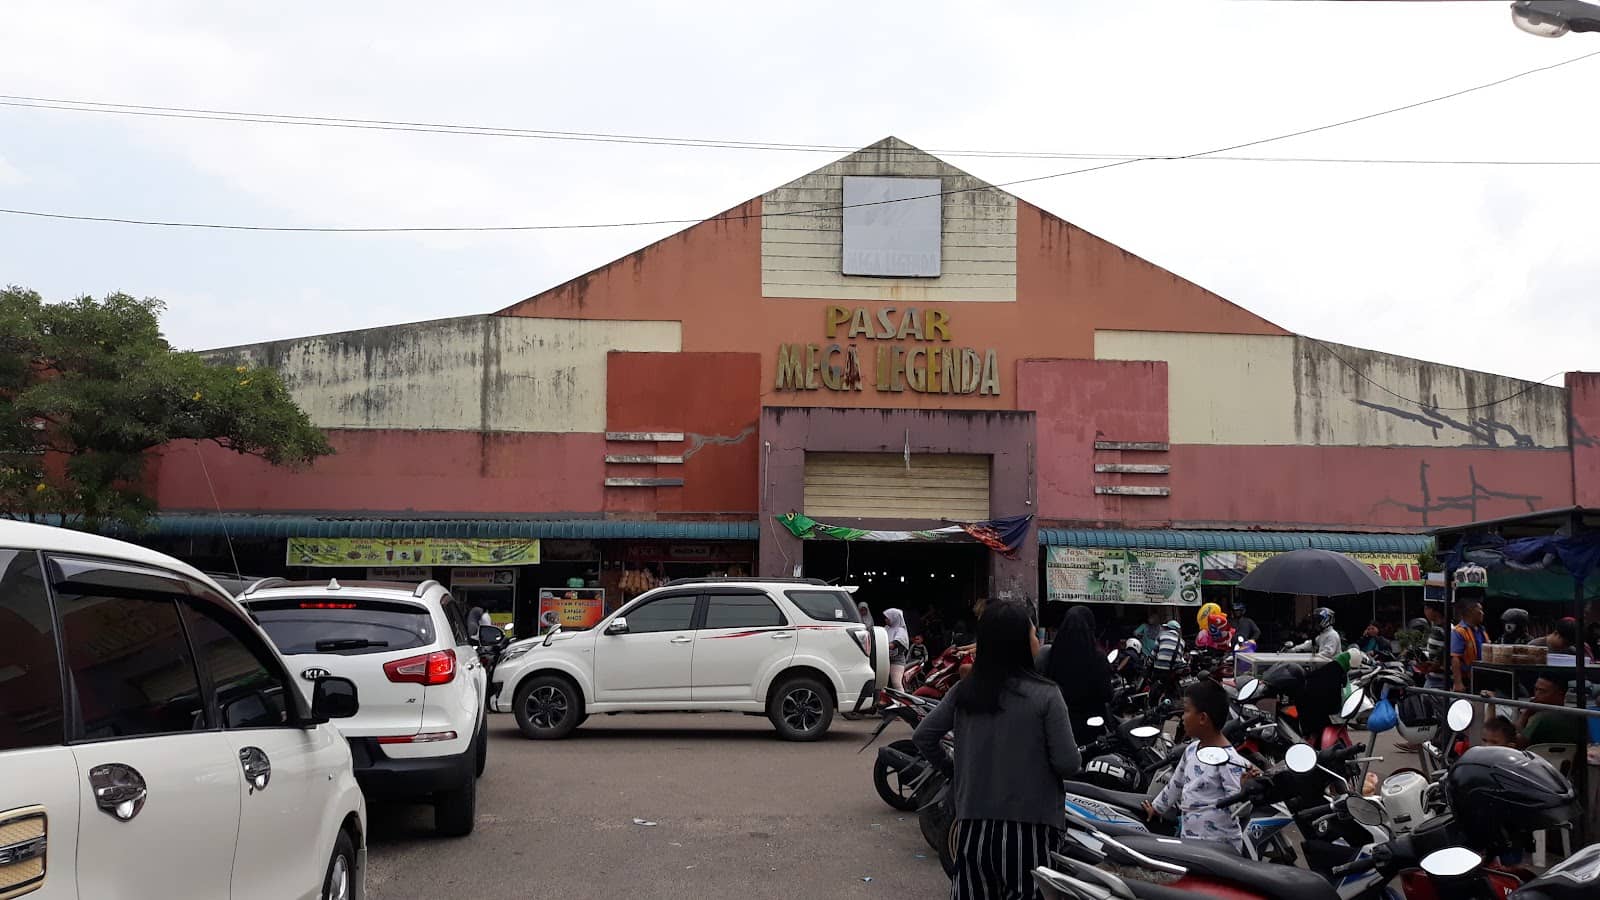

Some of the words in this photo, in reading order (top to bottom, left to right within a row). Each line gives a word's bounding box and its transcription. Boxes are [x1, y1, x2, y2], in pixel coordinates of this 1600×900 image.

[825, 304, 952, 341] PASAR
[775, 343, 863, 391] MEGA
[875, 344, 1001, 396] LEGENDA
[305, 669, 325, 679] KIA
